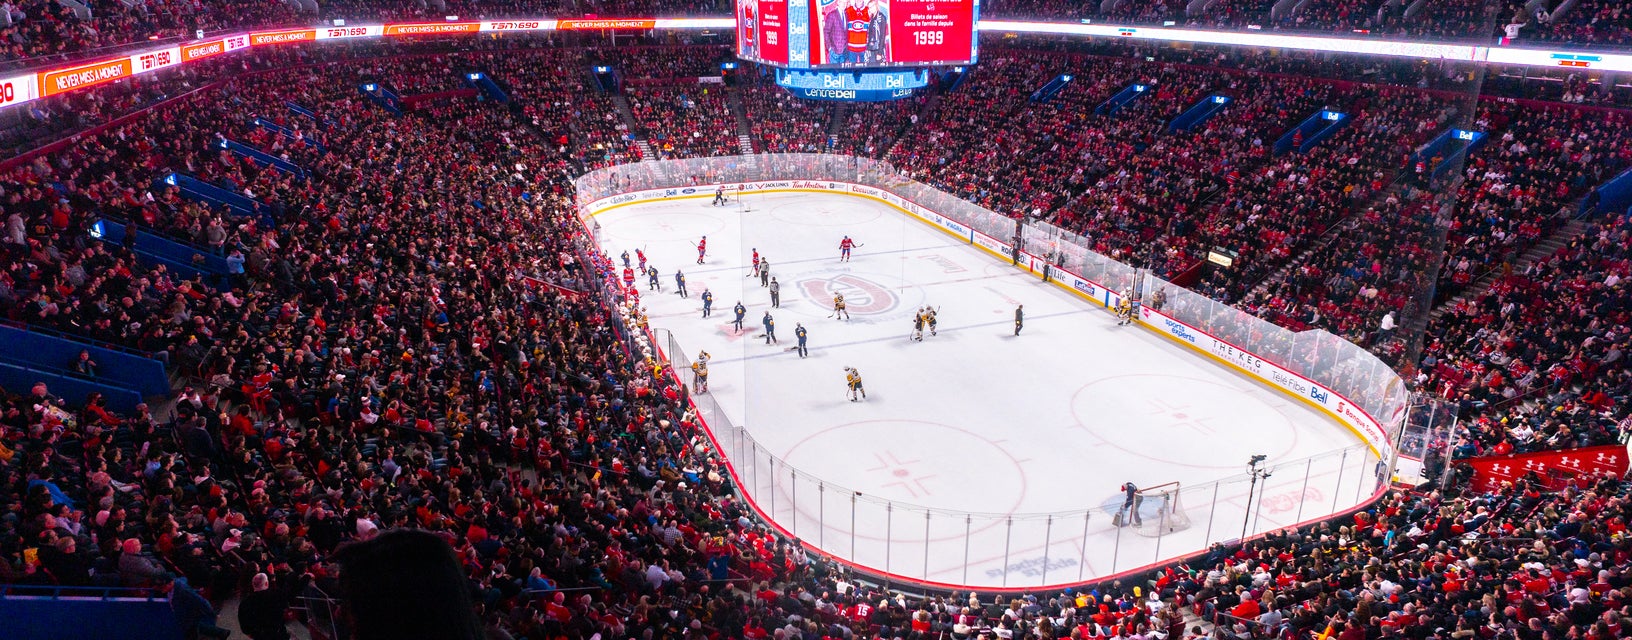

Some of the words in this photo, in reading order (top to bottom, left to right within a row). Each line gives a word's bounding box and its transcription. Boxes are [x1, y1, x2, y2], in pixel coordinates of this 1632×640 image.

[790, 22, 807, 34] Bell
[256, 35, 273, 43] NEVER
[913, 30, 944, 45] 1999
[790, 50, 807, 62] Bell
[56, 74, 80, 90] NEVER
[80, 72, 95, 86] MISS
[100, 64, 123, 80] MOMENT
[824, 75, 844, 88] Bell
[886, 75, 904, 88] Bell
[1459, 130, 1473, 140] Bell
[803, 181, 827, 189] Hortons
[1054, 270, 1066, 281] Life
[1165, 319, 1185, 332] sports
[1172, 328, 1196, 342] experts
[1213, 340, 1233, 355] THE
[1239, 352, 1261, 368] KEG
[1272, 370, 1288, 385] Télé
[1288, 379, 1306, 394] Fibe
[1310, 386, 1328, 404] Bell
[1345, 408, 1366, 428] Banque
[858, 606, 867, 616] 15
